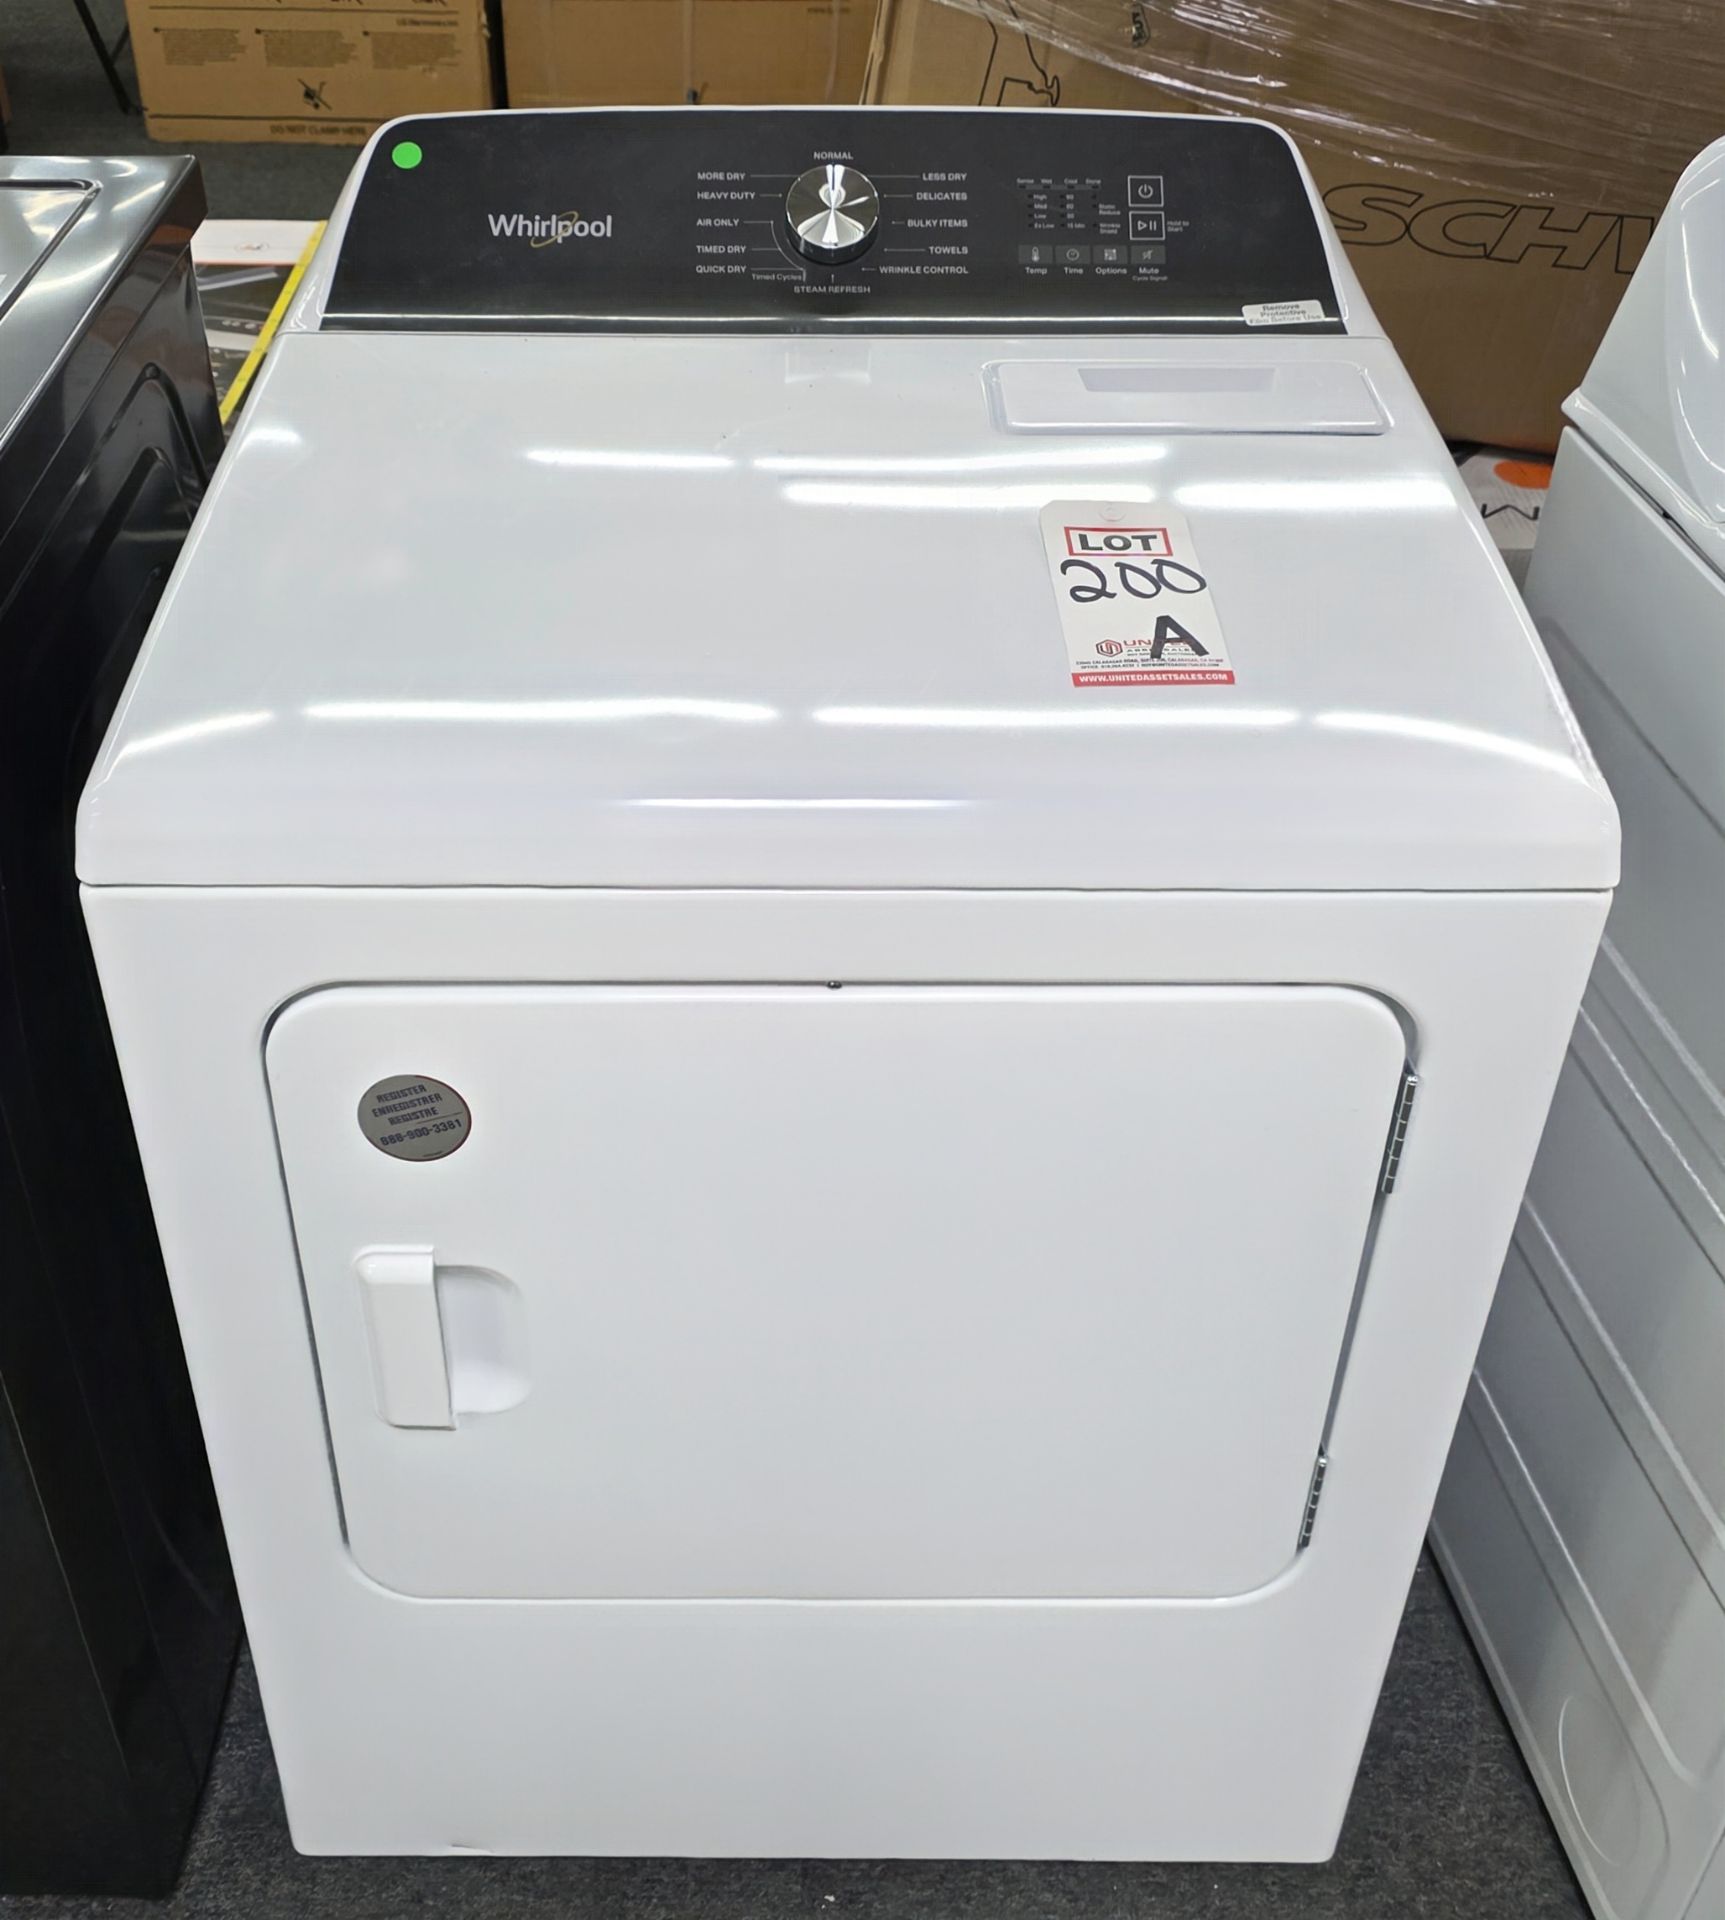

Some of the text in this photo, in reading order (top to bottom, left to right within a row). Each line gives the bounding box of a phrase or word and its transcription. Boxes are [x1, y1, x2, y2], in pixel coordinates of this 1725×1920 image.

[813, 151, 854, 160] NORMAL
[697, 172, 746, 181] MORE DRY
[922, 173, 967, 181] LESS DRY
[697, 191, 756, 200] HEAVY DUTY
[916, 192, 968, 201] DELICATES
[696, 218, 740, 227] AIR ONLY
[907, 219, 968, 228] BULKY ITEMS
[488, 213, 612, 244] Whirlpool
[1322, 183, 1655, 275] SCH
[696, 245, 746, 254] TIMED DRY
[928, 246, 969, 255] TOWELS
[696, 265, 747, 274] QUICK DRY
[879, 266, 969, 275] WRINKLE CONTROL
[1025, 266, 1048, 275] Temp
[1064, 266, 1084, 274] Time
[1095, 266, 1128, 275] Options
[751, 273, 803, 282] Timed Cycles
[794, 285, 871, 294] STEAM REFRESH
[1078, 533, 1158, 551] LOT
[1060, 558, 1207, 603] 200
[1150, 615, 1209, 660] A
[1079, 673, 1228, 683] WWW.UNITEDASSETSALES.COM
[376, 1084, 427, 1103] REGISTER
[371, 1093, 443, 1117] ENREGISTRER
[388, 1107, 440, 1125] REGISTRE
[380, 1118, 462, 1146] 888-900-3381
